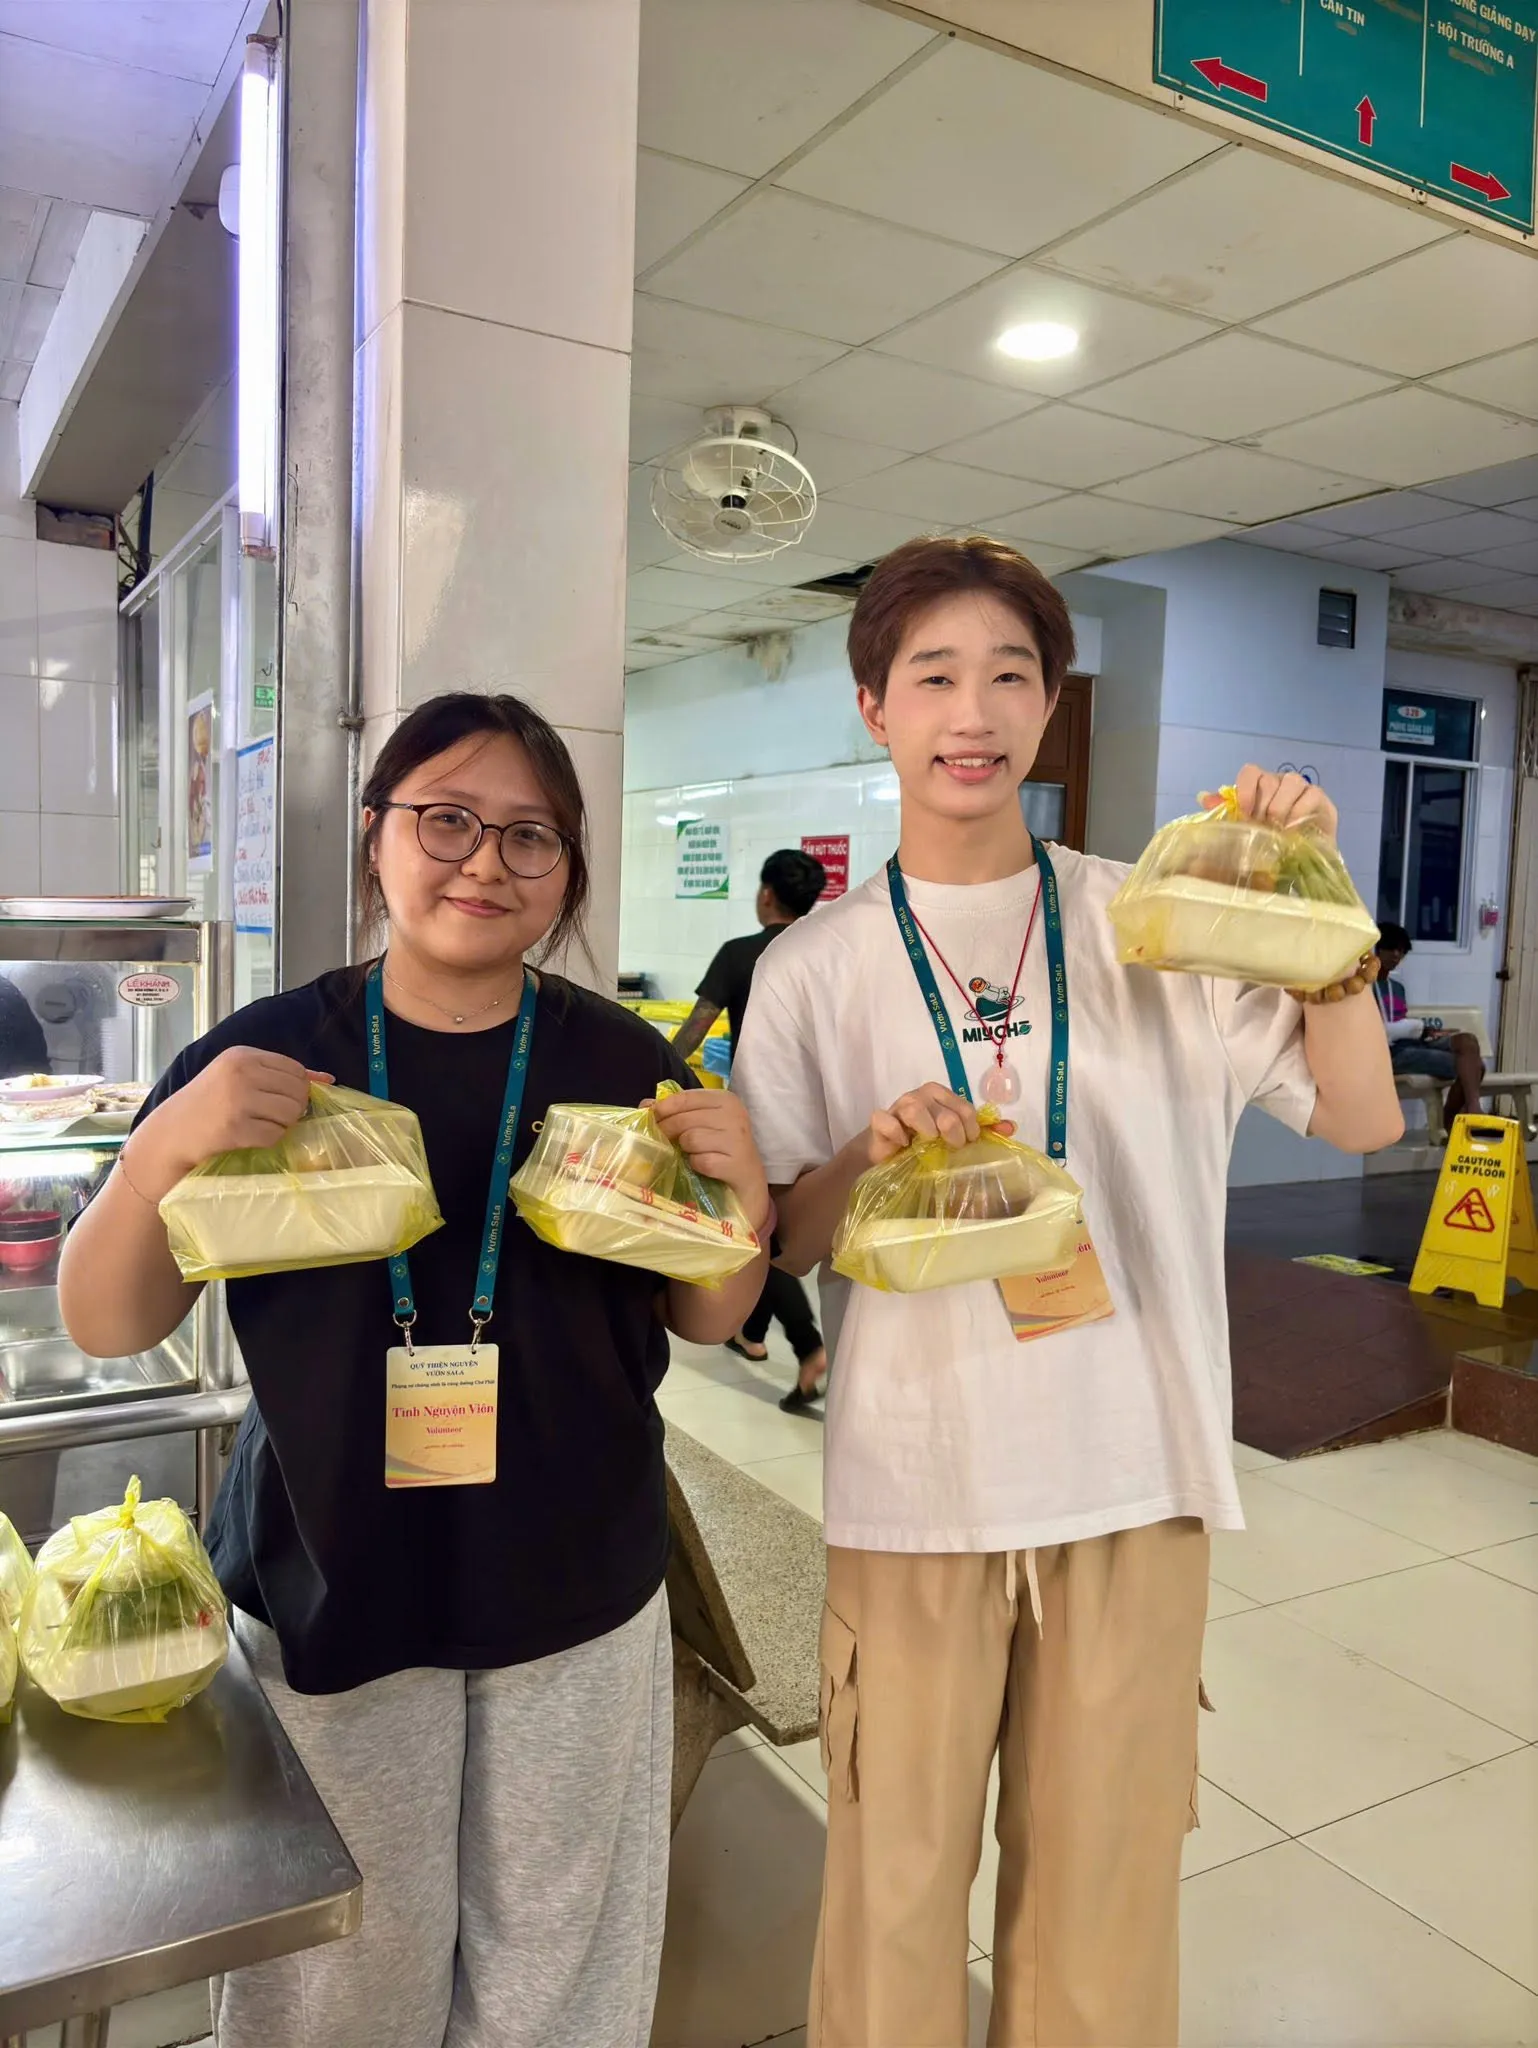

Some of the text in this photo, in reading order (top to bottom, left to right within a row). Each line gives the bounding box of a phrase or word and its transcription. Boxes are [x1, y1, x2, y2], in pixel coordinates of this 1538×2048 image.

[1346, 6, 1365, 27] TIN
[1479, 4, 1512, 31] GIẢNG
[1514, 21, 1536, 43] DẠY
[1437, 20, 1457, 42] HỘI
[1460, 31, 1504, 64] TRƯỜNG
[1506, 54, 1514, 69] A
[1056, 1061, 1065, 1081] SaLa
[1457, 1155, 1502, 1168] CAUTION
[1450, 1164, 1506, 1178] WET FLOOR
[491, 1205, 501, 1227] SaLa
[1035, 1268, 1070, 1285] Volunteer
[423, 1405, 466, 1418] Nguyện
[468, 1403, 494, 1414] Viên
[426, 1426, 463, 1435] Volunteer
